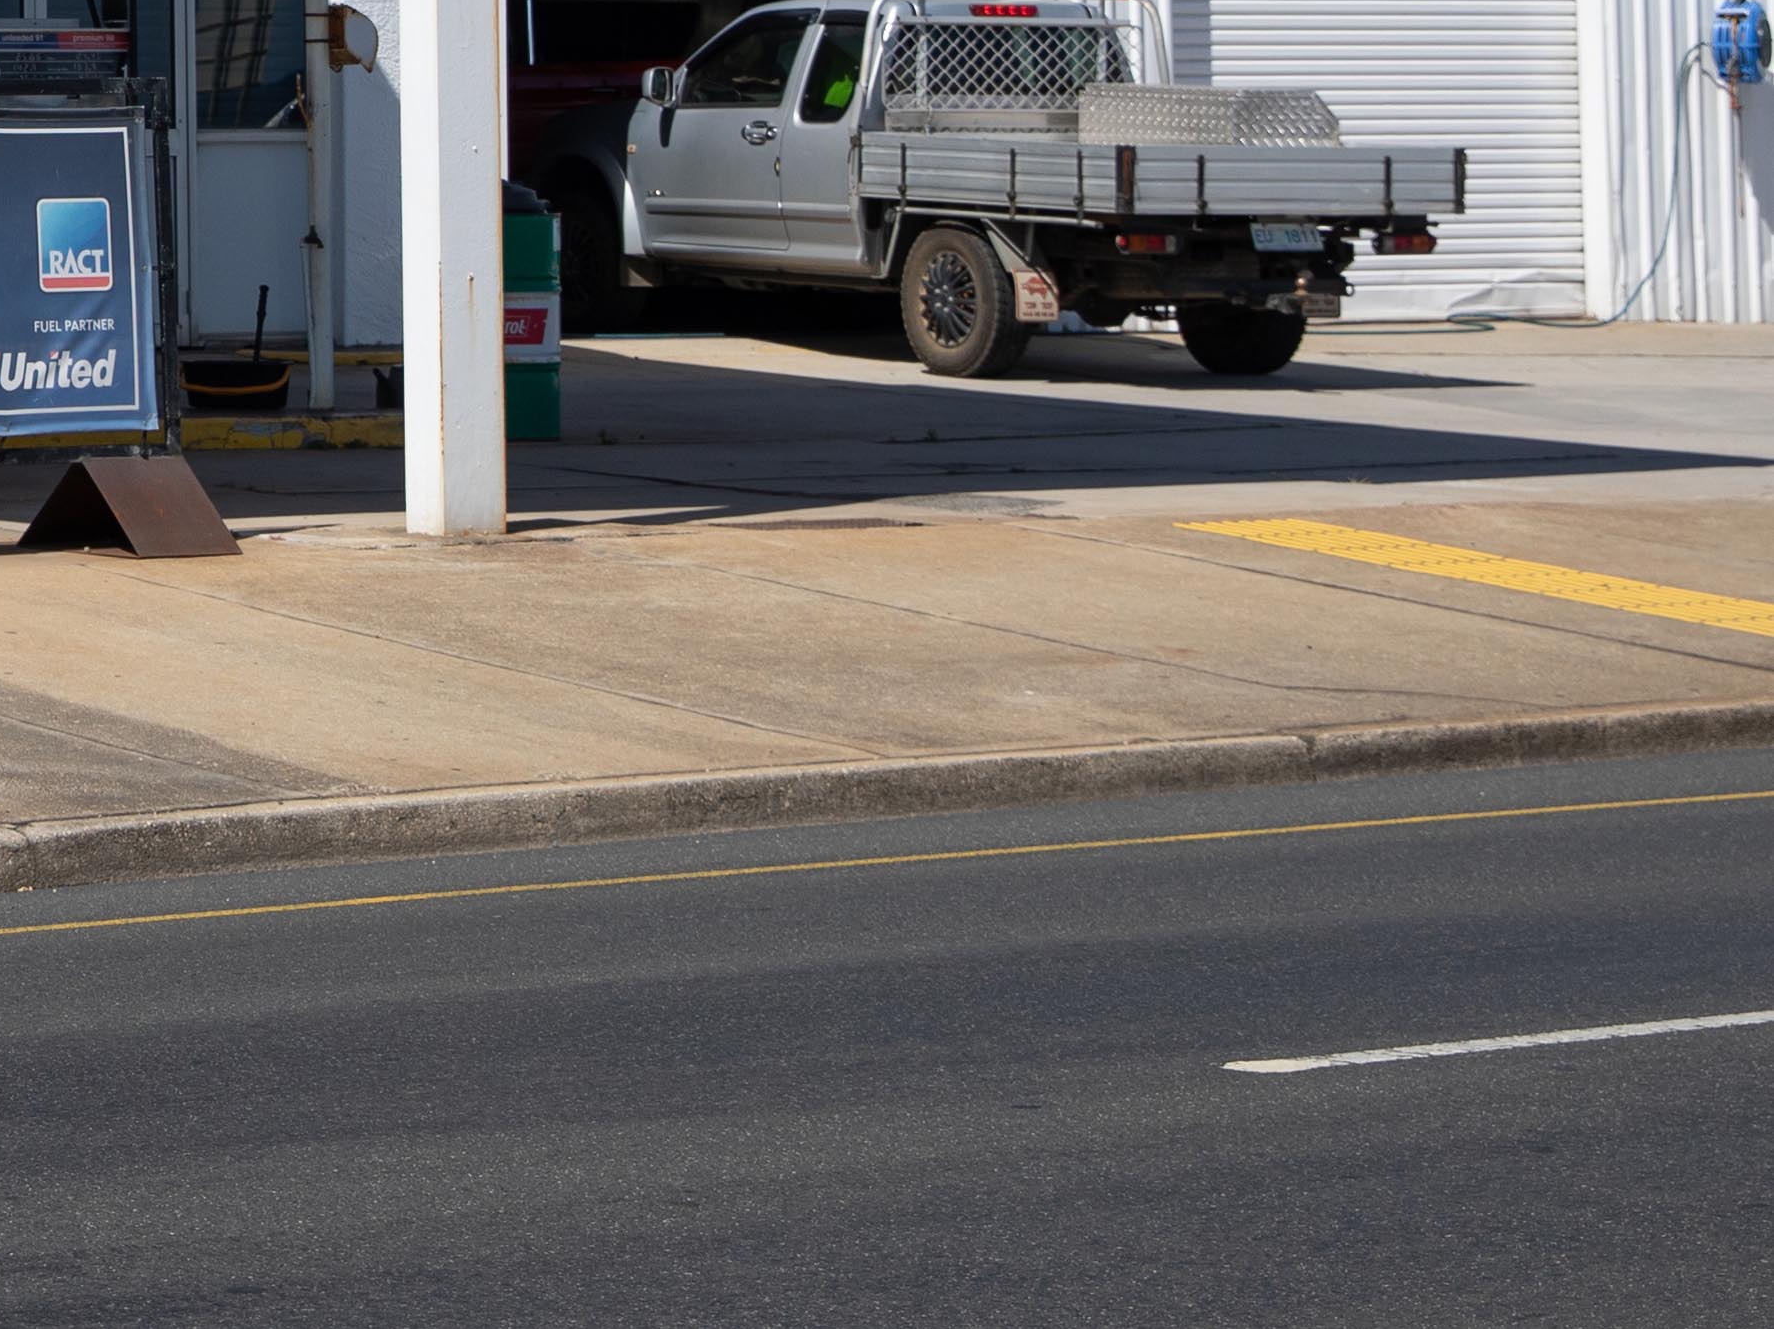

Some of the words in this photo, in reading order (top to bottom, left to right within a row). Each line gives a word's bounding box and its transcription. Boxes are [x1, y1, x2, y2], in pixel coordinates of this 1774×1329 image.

[49, 247, 104, 275] RACT
[34, 320, 62, 333] FUEL
[64, 318, 115, 331] PARTNER
[0, 349, 116, 391] United
